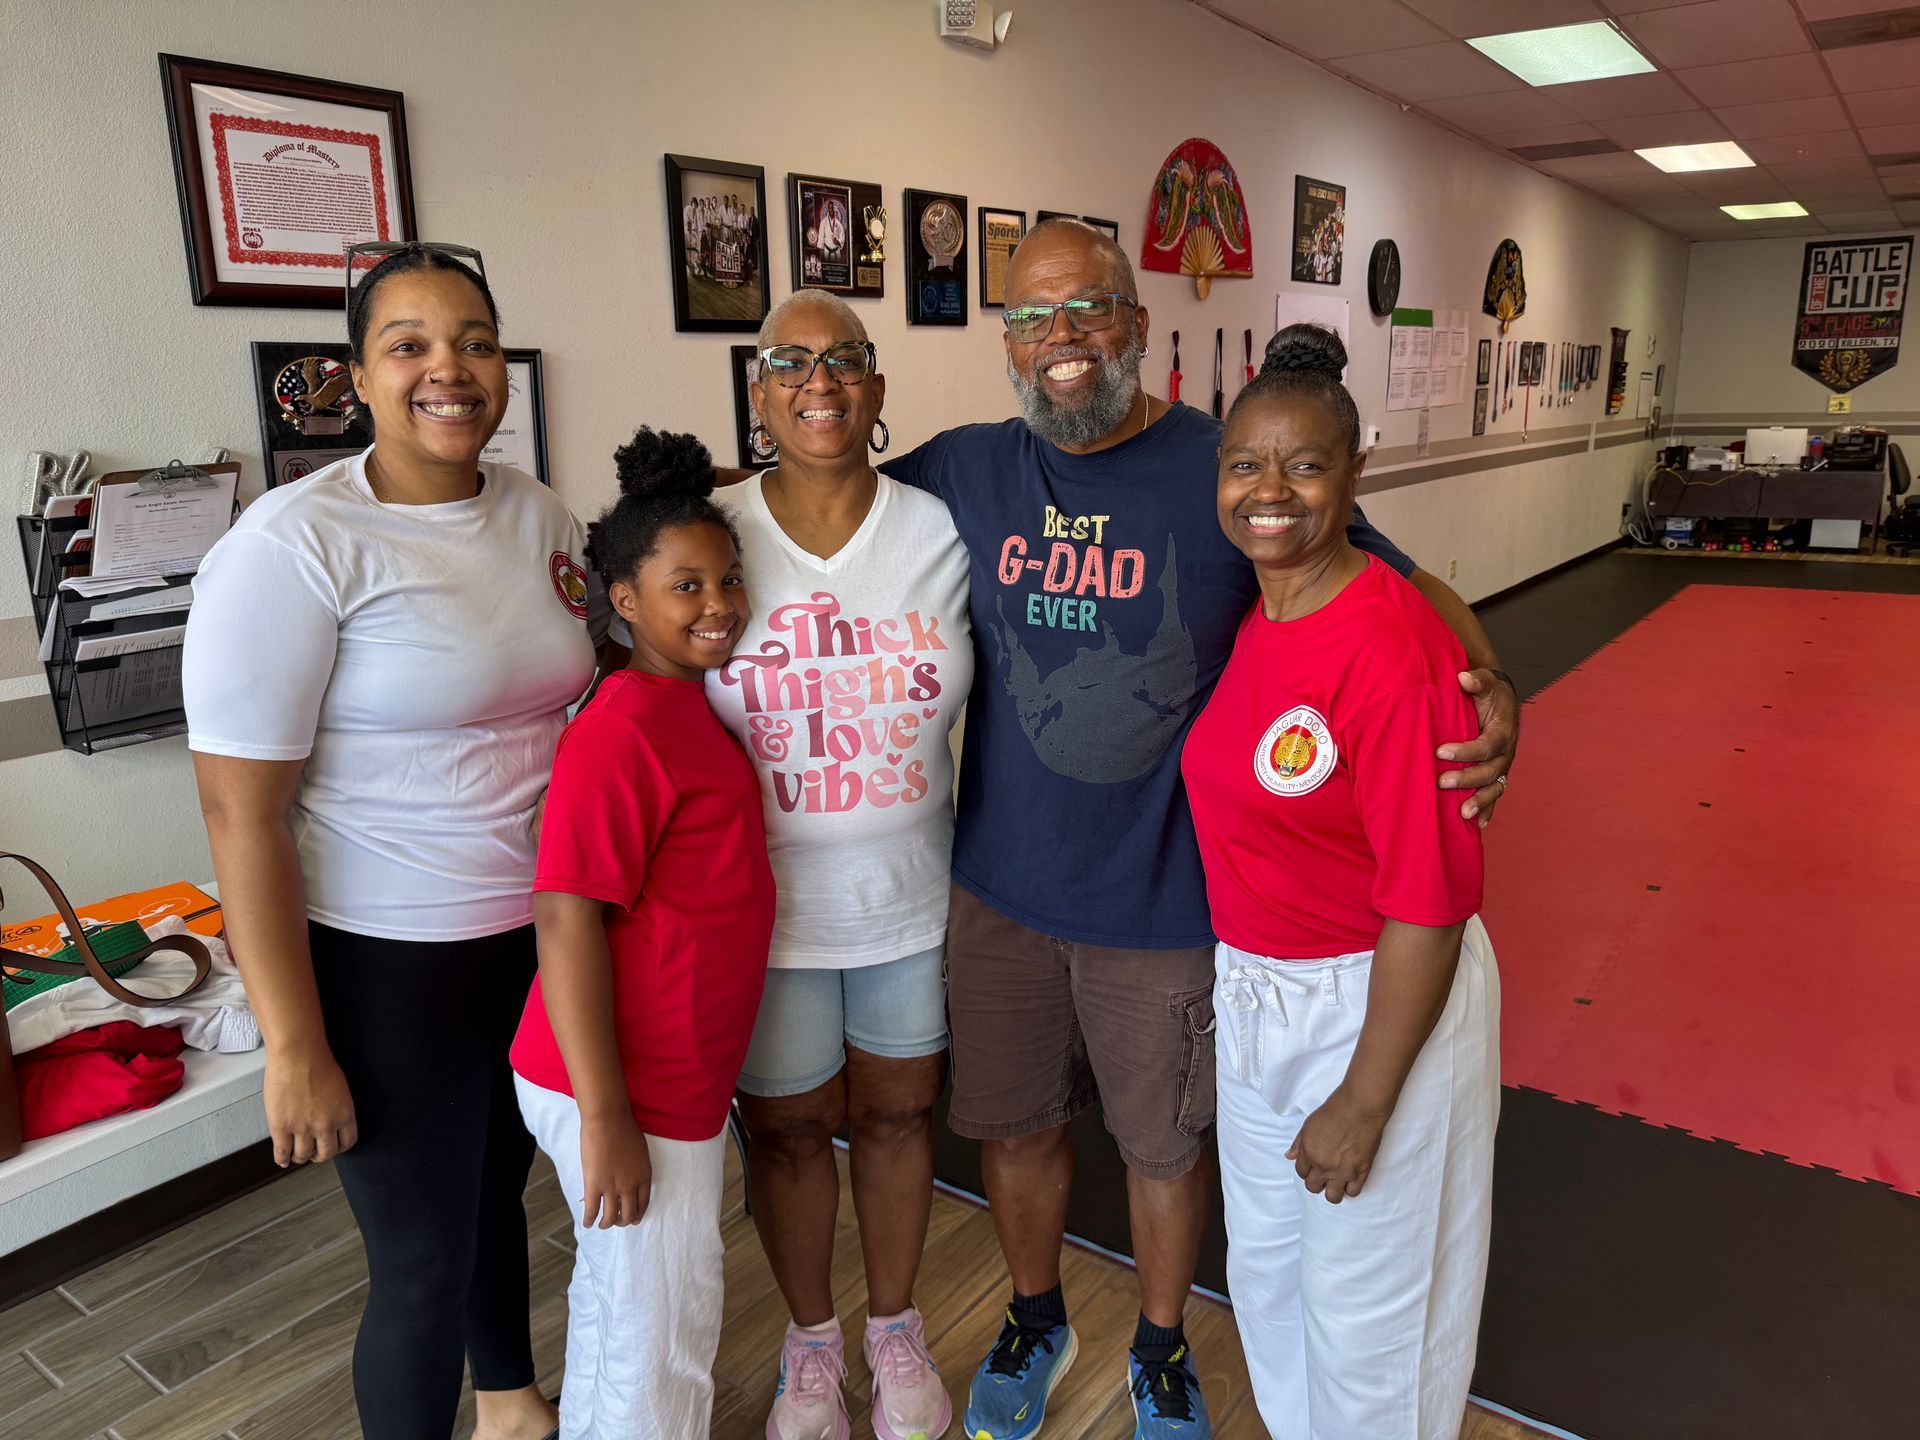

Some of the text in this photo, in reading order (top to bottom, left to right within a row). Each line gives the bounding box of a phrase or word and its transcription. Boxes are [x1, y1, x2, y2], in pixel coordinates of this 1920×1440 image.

[262, 142, 340, 169] Diploma of Mastery
[988, 222, 1020, 240] Sports
[1812, 245, 1904, 275] BATTLE
[1811, 276, 1824, 310] OF THE
[1826, 273, 1901, 309] CUP
[1825, 314, 1873, 332] PLACE
[1799, 340, 1836, 349] 2020
[1883, 338, 1896, 346] TX
[1043, 505, 1110, 545] BEST
[998, 535, 1146, 599] G-DAD
[768, 591, 949, 659] Thick
[1026, 593, 1098, 633] EVER
[720, 640, 942, 720] Thighs
[748, 709, 921, 763] & love
[1304, 716, 1328, 745] DOJO
[772, 759, 929, 813] vibes
[1299, 754, 1329, 788] MENTORSHIP
